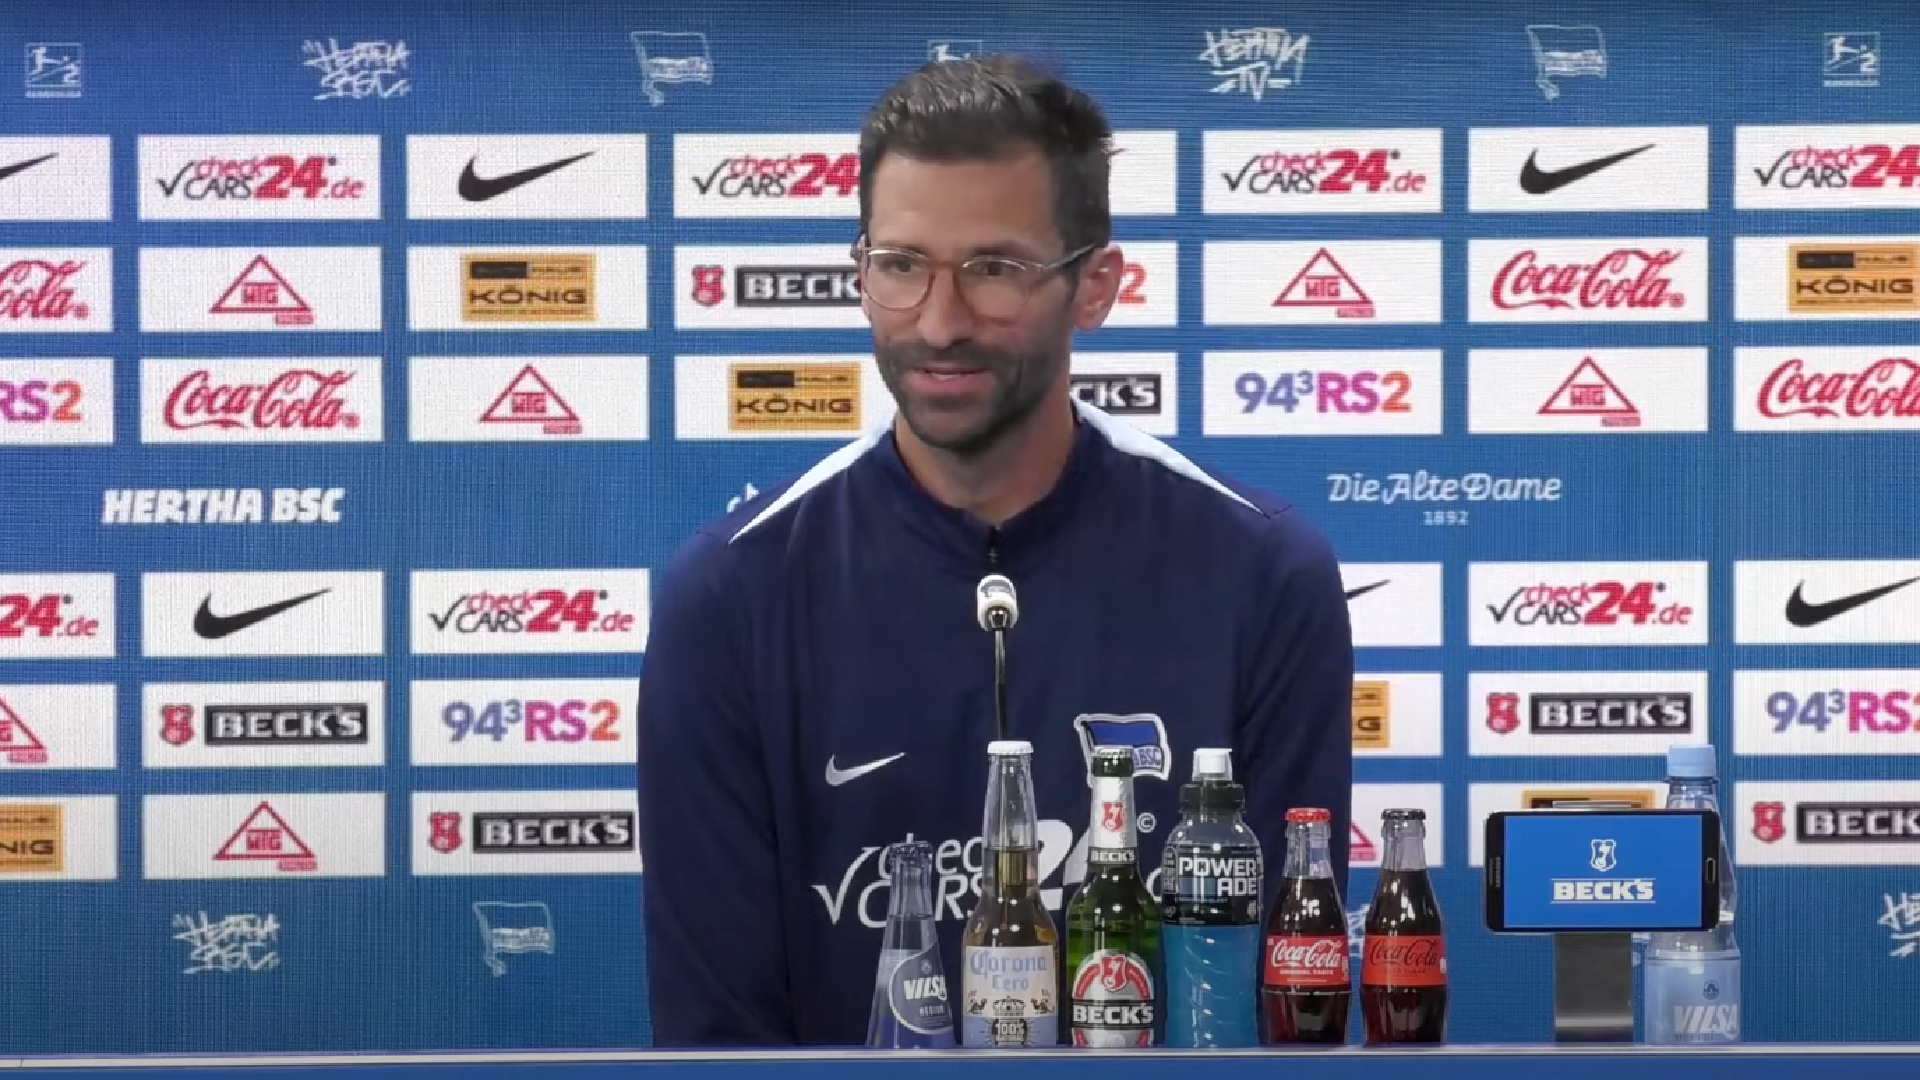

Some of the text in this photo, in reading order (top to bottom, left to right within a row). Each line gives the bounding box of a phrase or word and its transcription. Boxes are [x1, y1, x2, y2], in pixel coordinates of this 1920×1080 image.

[184, 176, 251, 200] CARS
[720, 174, 785, 197] CARS
[1250, 172, 1315, 194] CARS
[1780, 166, 1848, 188] CARS
[1491, 249, 1685, 310] Coca-Cola
[1796, 275, 1914, 294] KÖNIG
[470, 285, 587, 304] KÖNIG
[163, 369, 358, 430] Coca-Cola
[737, 394, 854, 413] KÖNIG
[1326, 470, 1562, 505] Die Alte Dame
[103, 487, 346, 524] HERTHA BSC
[1422, 511, 1469, 526] 1892
[456, 611, 523, 633] CARS
[1514, 602, 1582, 625] CARS
[212, 706, 363, 738] BECK'S
[1537, 696, 1687, 728] BECK'S
[480, 814, 630, 846] BECK'S
[1178, 857, 1257, 877] POWER
[1217, 878, 1257, 896] ADE
[1553, 878, 1654, 901] BECK'S
[970, 949, 1047, 979] Corona
[1272, 939, 1342, 968] Coca-Cola
[1369, 938, 1437, 967] Coca-Cola
[992, 974, 1029, 990] Cero
[1073, 1003, 1154, 1024] BECK'S
